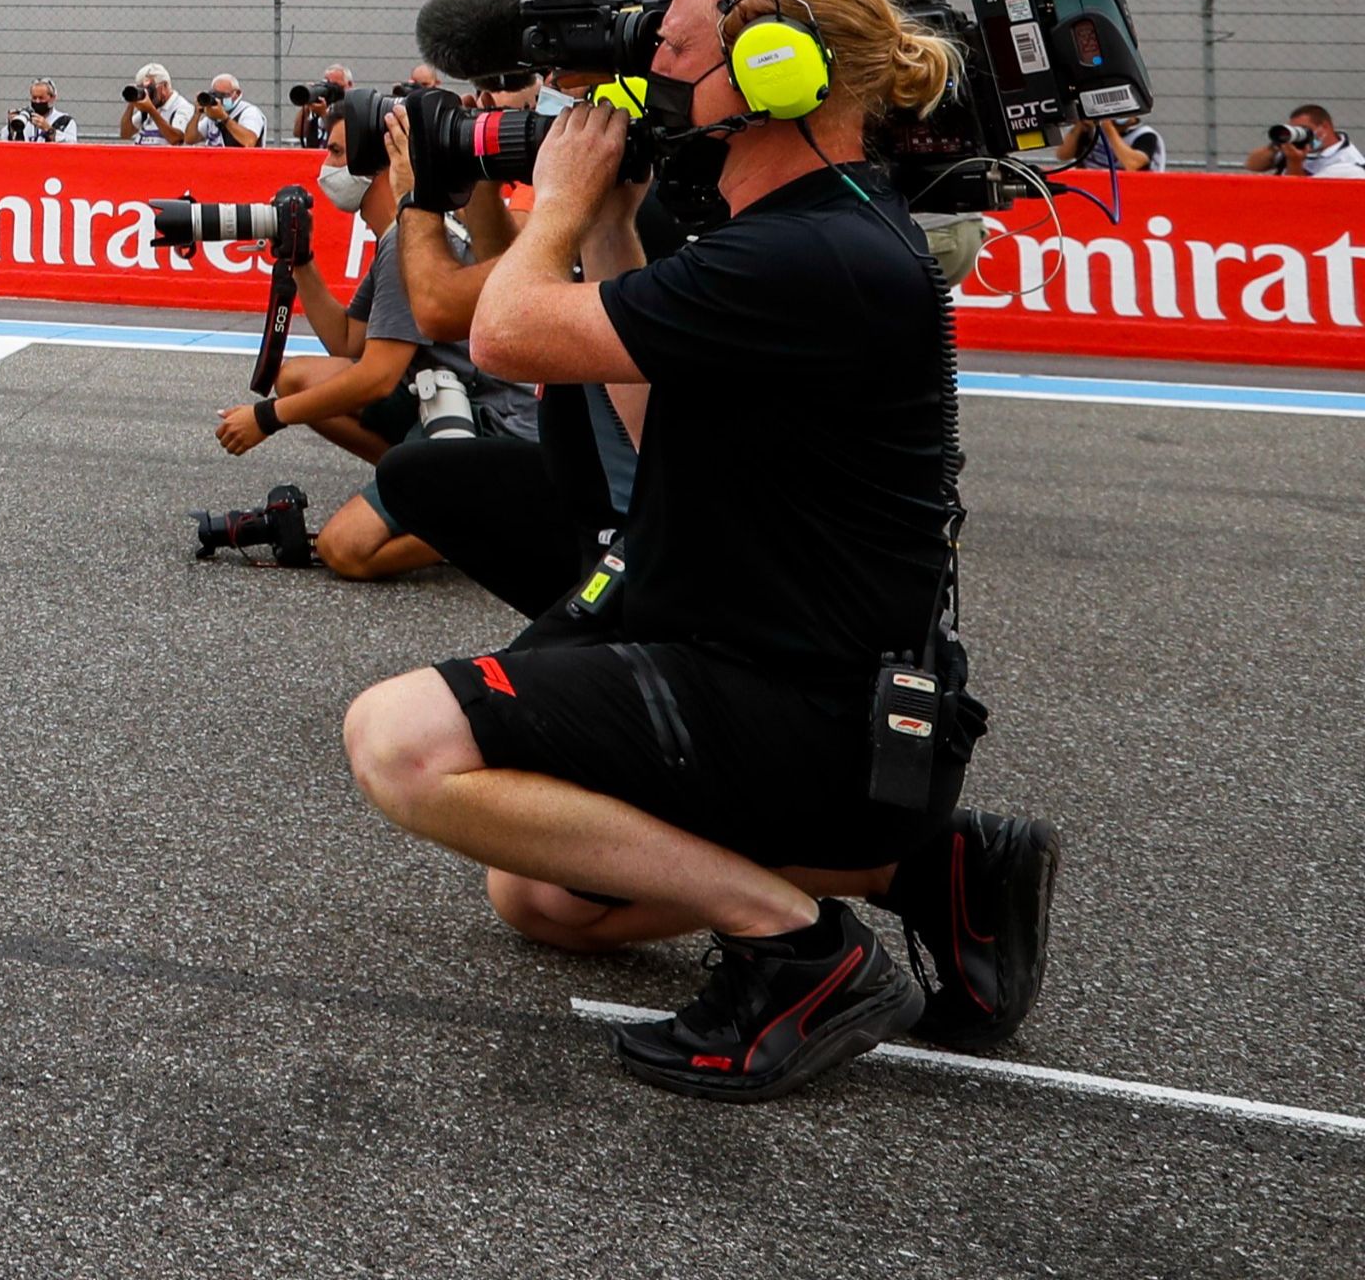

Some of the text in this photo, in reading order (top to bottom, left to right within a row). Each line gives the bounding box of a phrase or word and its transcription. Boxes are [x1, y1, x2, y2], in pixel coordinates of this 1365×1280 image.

[1006, 99, 1059, 119] DTC
[1010, 117, 1039, 131] HEVC
[274, 305, 289, 333] EOS
